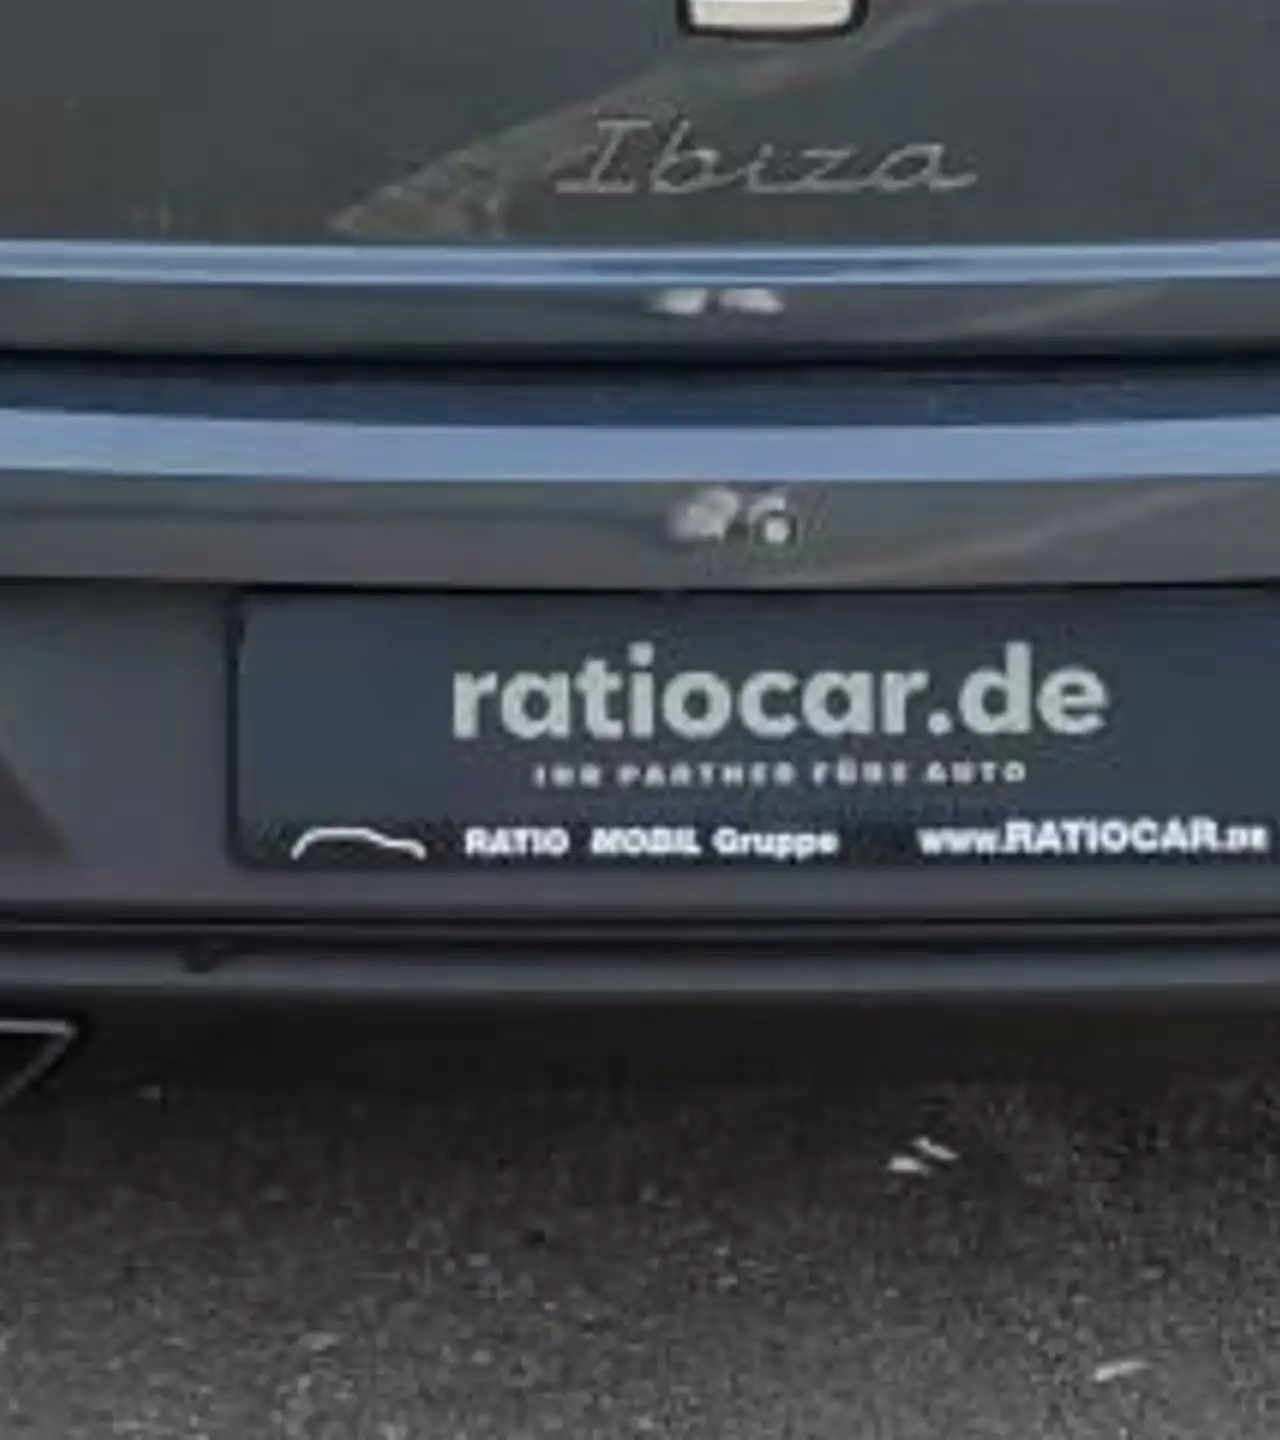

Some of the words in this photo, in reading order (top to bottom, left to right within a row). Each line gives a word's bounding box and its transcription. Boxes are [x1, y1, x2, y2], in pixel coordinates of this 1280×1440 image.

[556, 118, 977, 194] Ibiza
[452, 640, 1110, 740] ratiocar.de
[534, 762, 602, 788] IHR
[616, 761, 796, 788] PARTNER
[926, 760, 1027, 785] AUTO
[464, 826, 570, 855] RATIO
[591, 826, 703, 855] MOBIL
[711, 826, 839, 860] Gruppe
